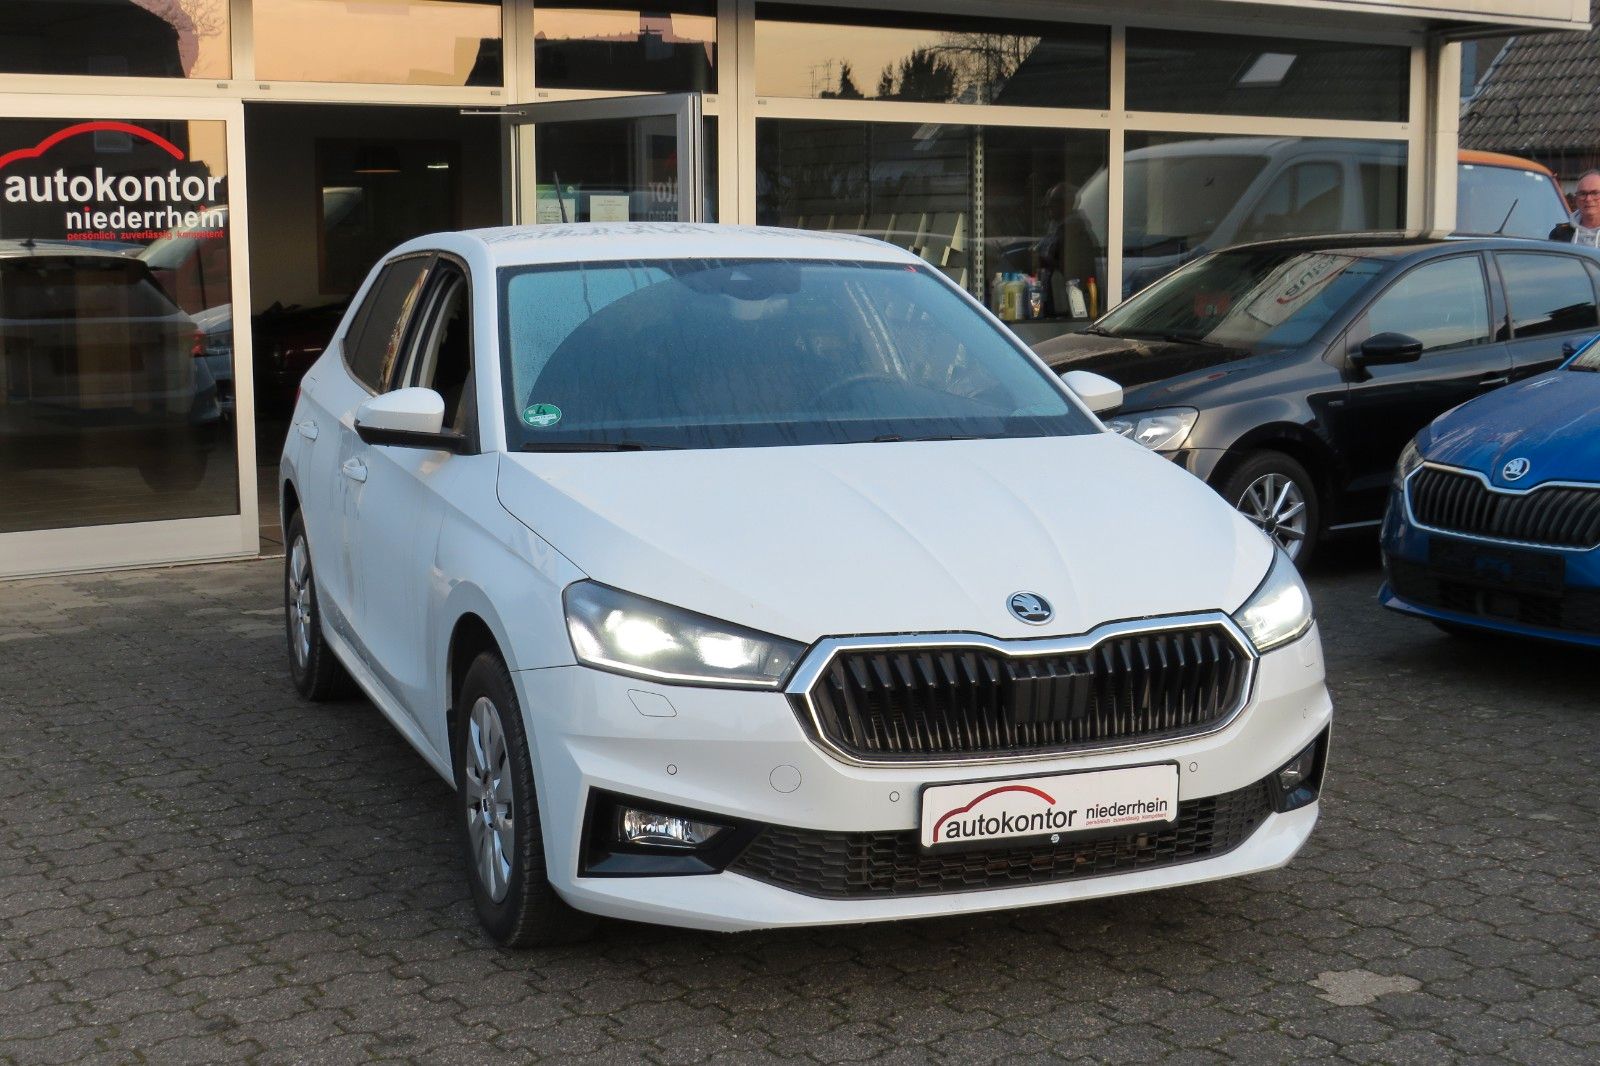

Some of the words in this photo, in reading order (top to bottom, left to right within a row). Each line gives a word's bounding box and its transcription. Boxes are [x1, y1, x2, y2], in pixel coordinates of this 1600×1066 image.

[4, 166, 225, 203] autokontor
[66, 204, 225, 230] niederrhein
[66, 231, 116, 242] persönlich
[120, 230, 173, 241] zuverlässig
[945, 807, 1078, 840] autokontor
[1085, 797, 1168, 820] niederrhein
